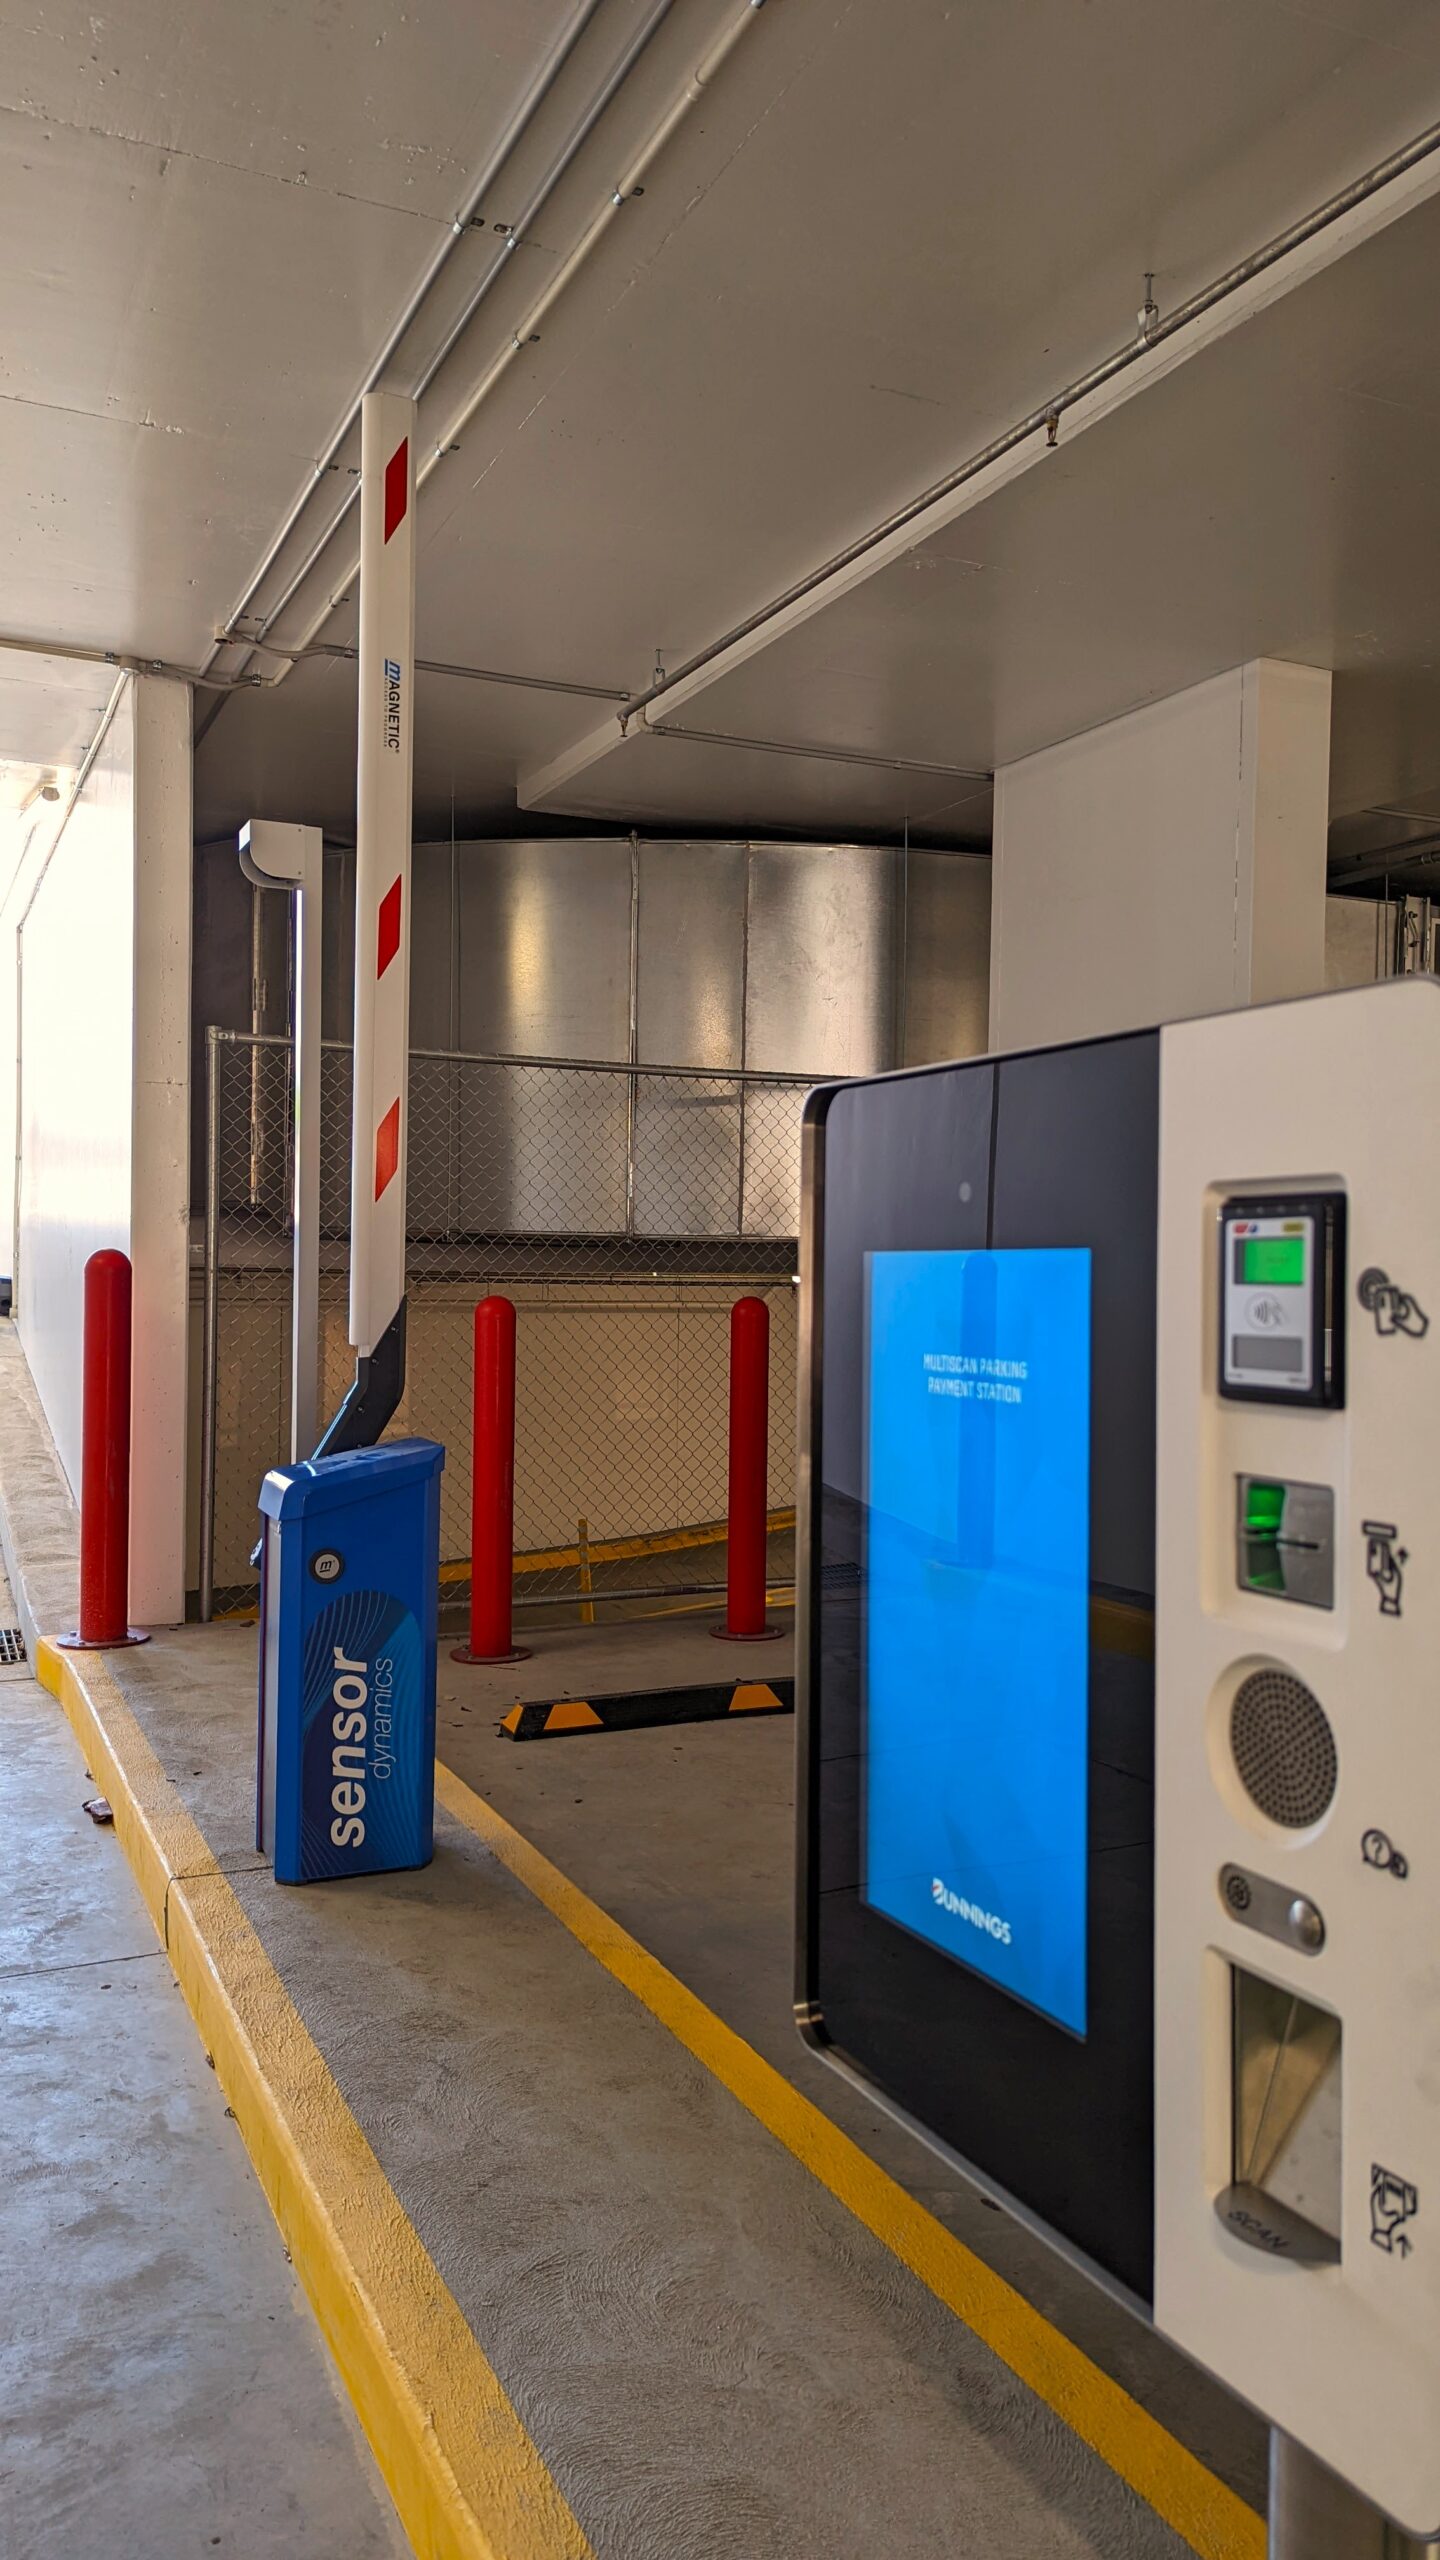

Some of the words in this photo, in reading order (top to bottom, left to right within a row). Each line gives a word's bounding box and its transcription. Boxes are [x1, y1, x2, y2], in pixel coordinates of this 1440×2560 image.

[923, 1352, 978, 1374] MULTISCAN
[980, 1357, 1028, 1380] PARKING
[927, 1376, 974, 1398] PAYMENT
[976, 1381, 1022, 1404] STATION
[368, 1657, 396, 1780] dynamics
[330, 1646, 368, 1848] sensor
[931, 1877, 1012, 1945] BUNNINGS
[1228, 2211, 1289, 2249] SCAN
